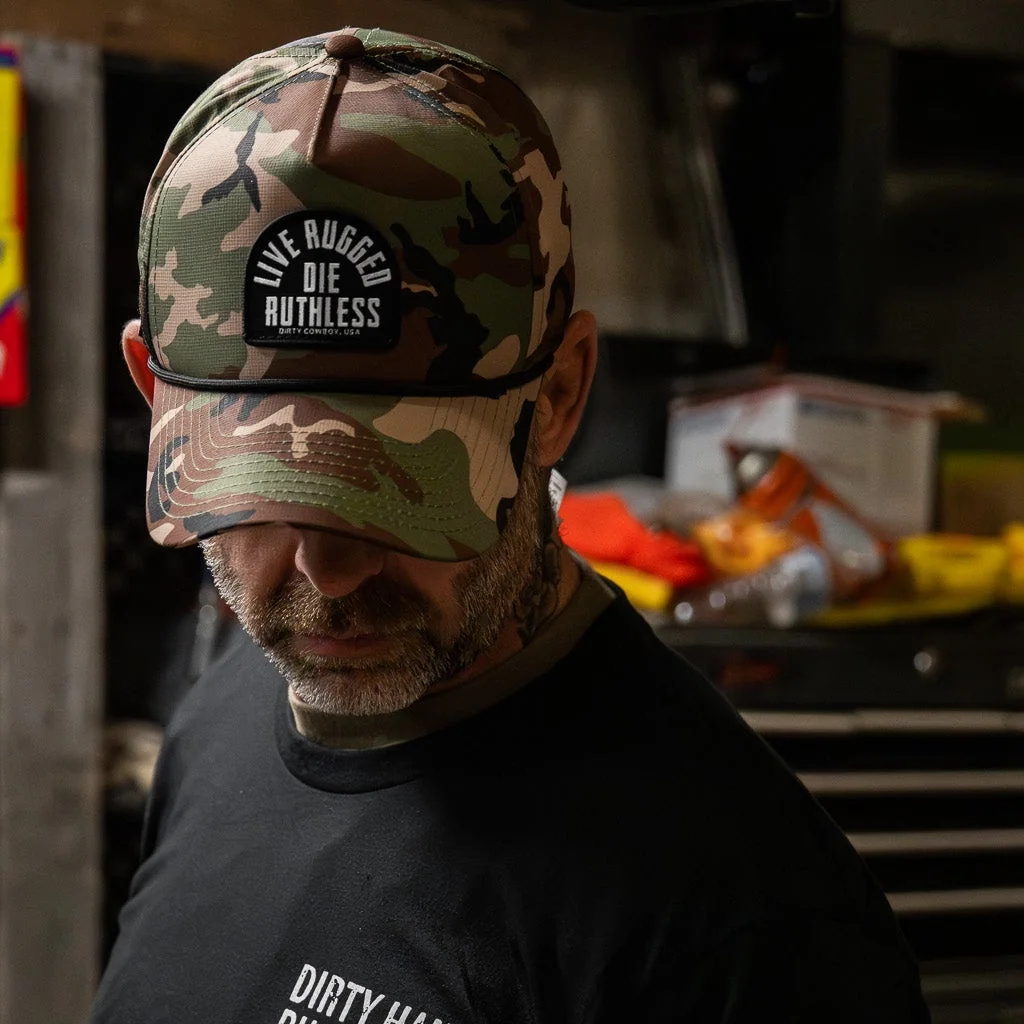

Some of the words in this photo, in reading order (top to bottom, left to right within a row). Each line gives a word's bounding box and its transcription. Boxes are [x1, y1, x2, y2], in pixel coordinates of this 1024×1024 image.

[253, 229, 301, 288] LIVE
[303, 219, 392, 288] RUGGED
[303, 262, 340, 294] DIE
[264, 296, 380, 328] RUTHLESS
[278, 327, 301, 335] DIRTY
[344, 328, 361, 336] USA
